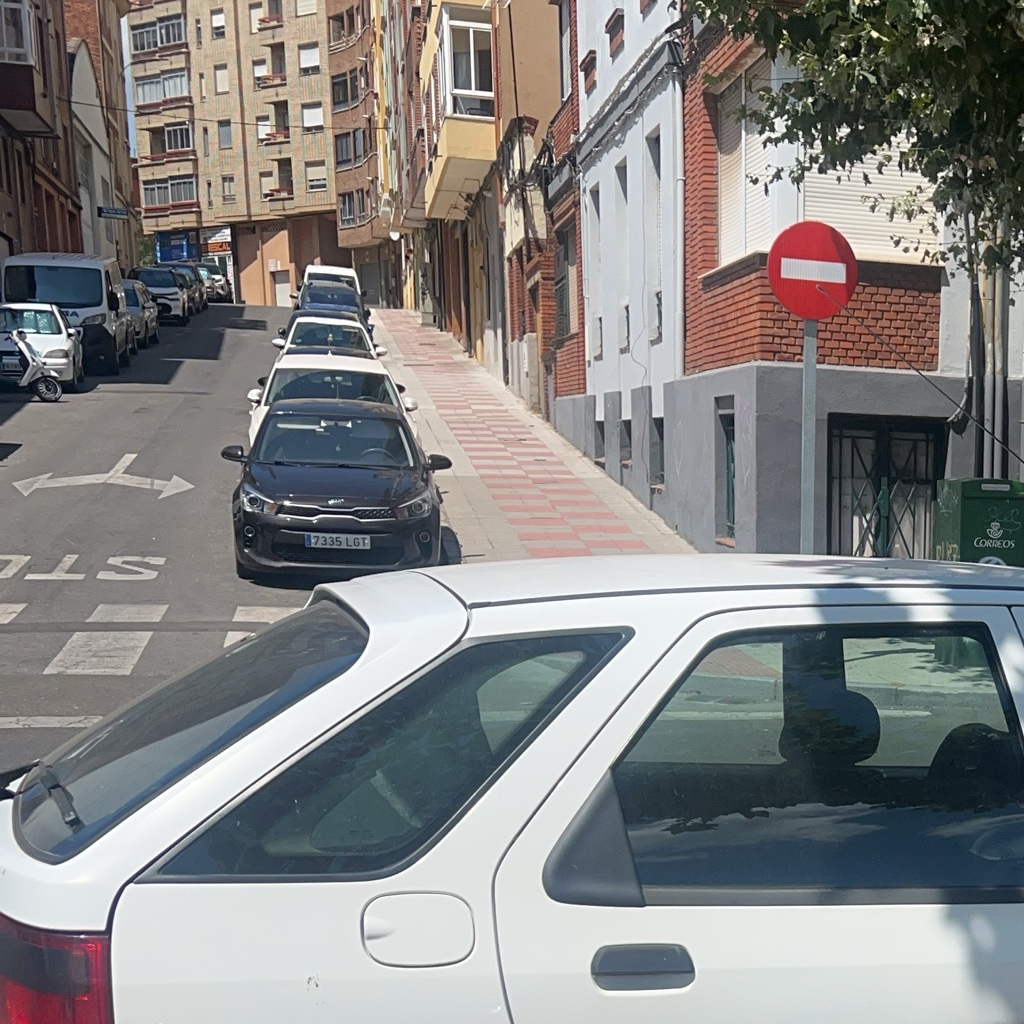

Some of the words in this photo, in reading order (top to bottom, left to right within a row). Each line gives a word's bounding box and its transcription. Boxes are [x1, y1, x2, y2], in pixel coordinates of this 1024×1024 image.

[313, 535, 342, 547] 7335
[346, 537, 367, 548] LGT
[974, 537, 1016, 549] CORREOS
